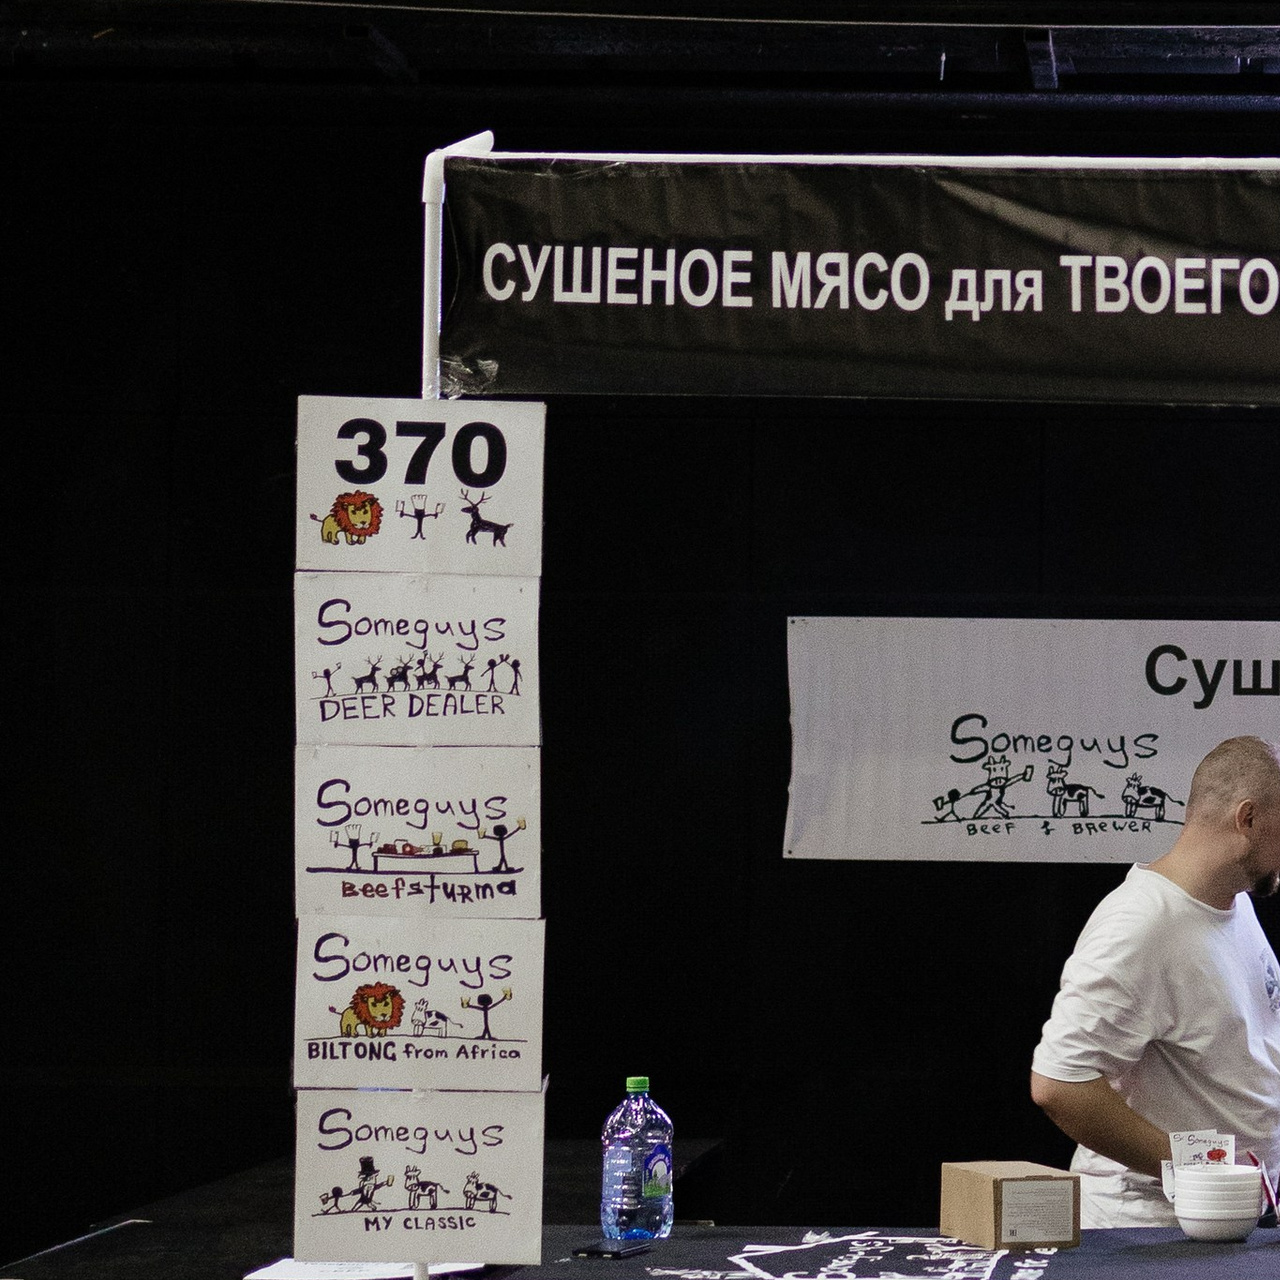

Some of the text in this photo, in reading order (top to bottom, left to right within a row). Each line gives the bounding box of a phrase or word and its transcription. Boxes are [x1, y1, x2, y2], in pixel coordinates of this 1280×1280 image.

[482, 242, 753, 308] СУШЕНОЕ
[771, 250, 930, 312] МЯСО
[944, 268, 1043, 322] для
[1059, 255, 1280, 316] ТВОЕГО
[334, 417, 507, 489] 370
[316, 597, 507, 653] Someguys
[319, 693, 505, 722] DEER DEALER
[950, 713, 1159, 768] Someguys
[316, 778, 508, 830] Someguys
[312, 932, 513, 989] Someguys
[307, 1040, 521, 1061] BILTONG from Africa
[317, 1107, 505, 1156] Someguys
[363, 1215, 477, 1232] MY CLASSIC
